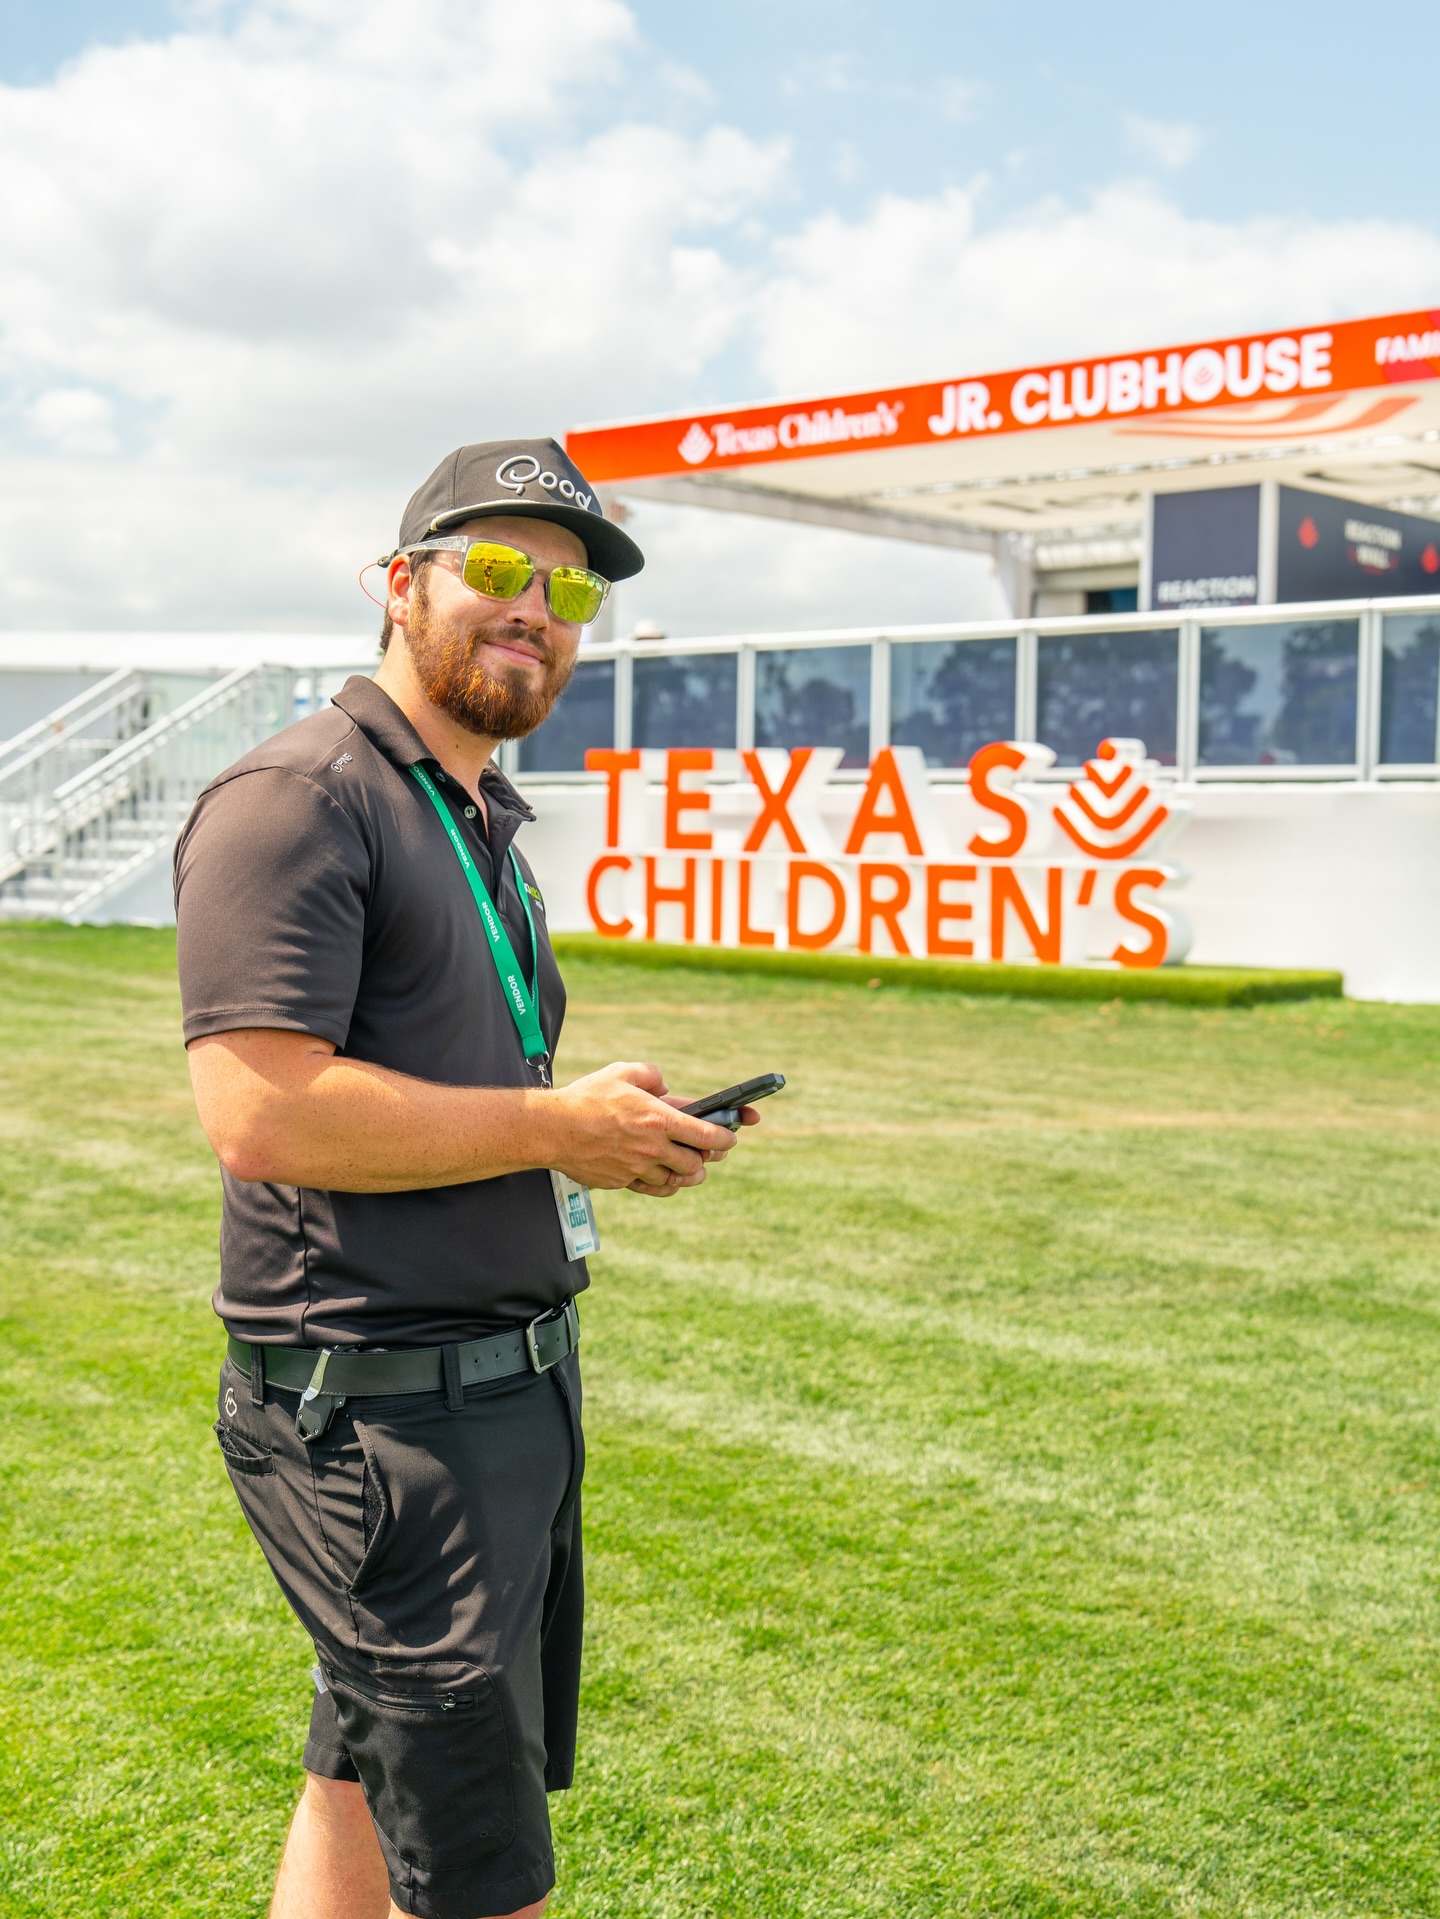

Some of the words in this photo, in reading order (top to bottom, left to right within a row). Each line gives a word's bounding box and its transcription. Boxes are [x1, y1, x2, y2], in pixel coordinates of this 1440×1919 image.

[928, 381, 1003, 436] JR.
[1010, 331, 1333, 425] CLUBHOUSE
[711, 423, 778, 457] Texas
[1158, 575, 1256, 603] REACTION
[412, 763, 435, 796] VENDO
[585, 742, 1028, 858] TEXAS
[450, 829, 470, 869] VENDOR
[482, 901, 500, 942] VENDOR
[586, 855, 1168, 969] CHILDREN'S
[507, 974, 526, 1015] VENDOR
